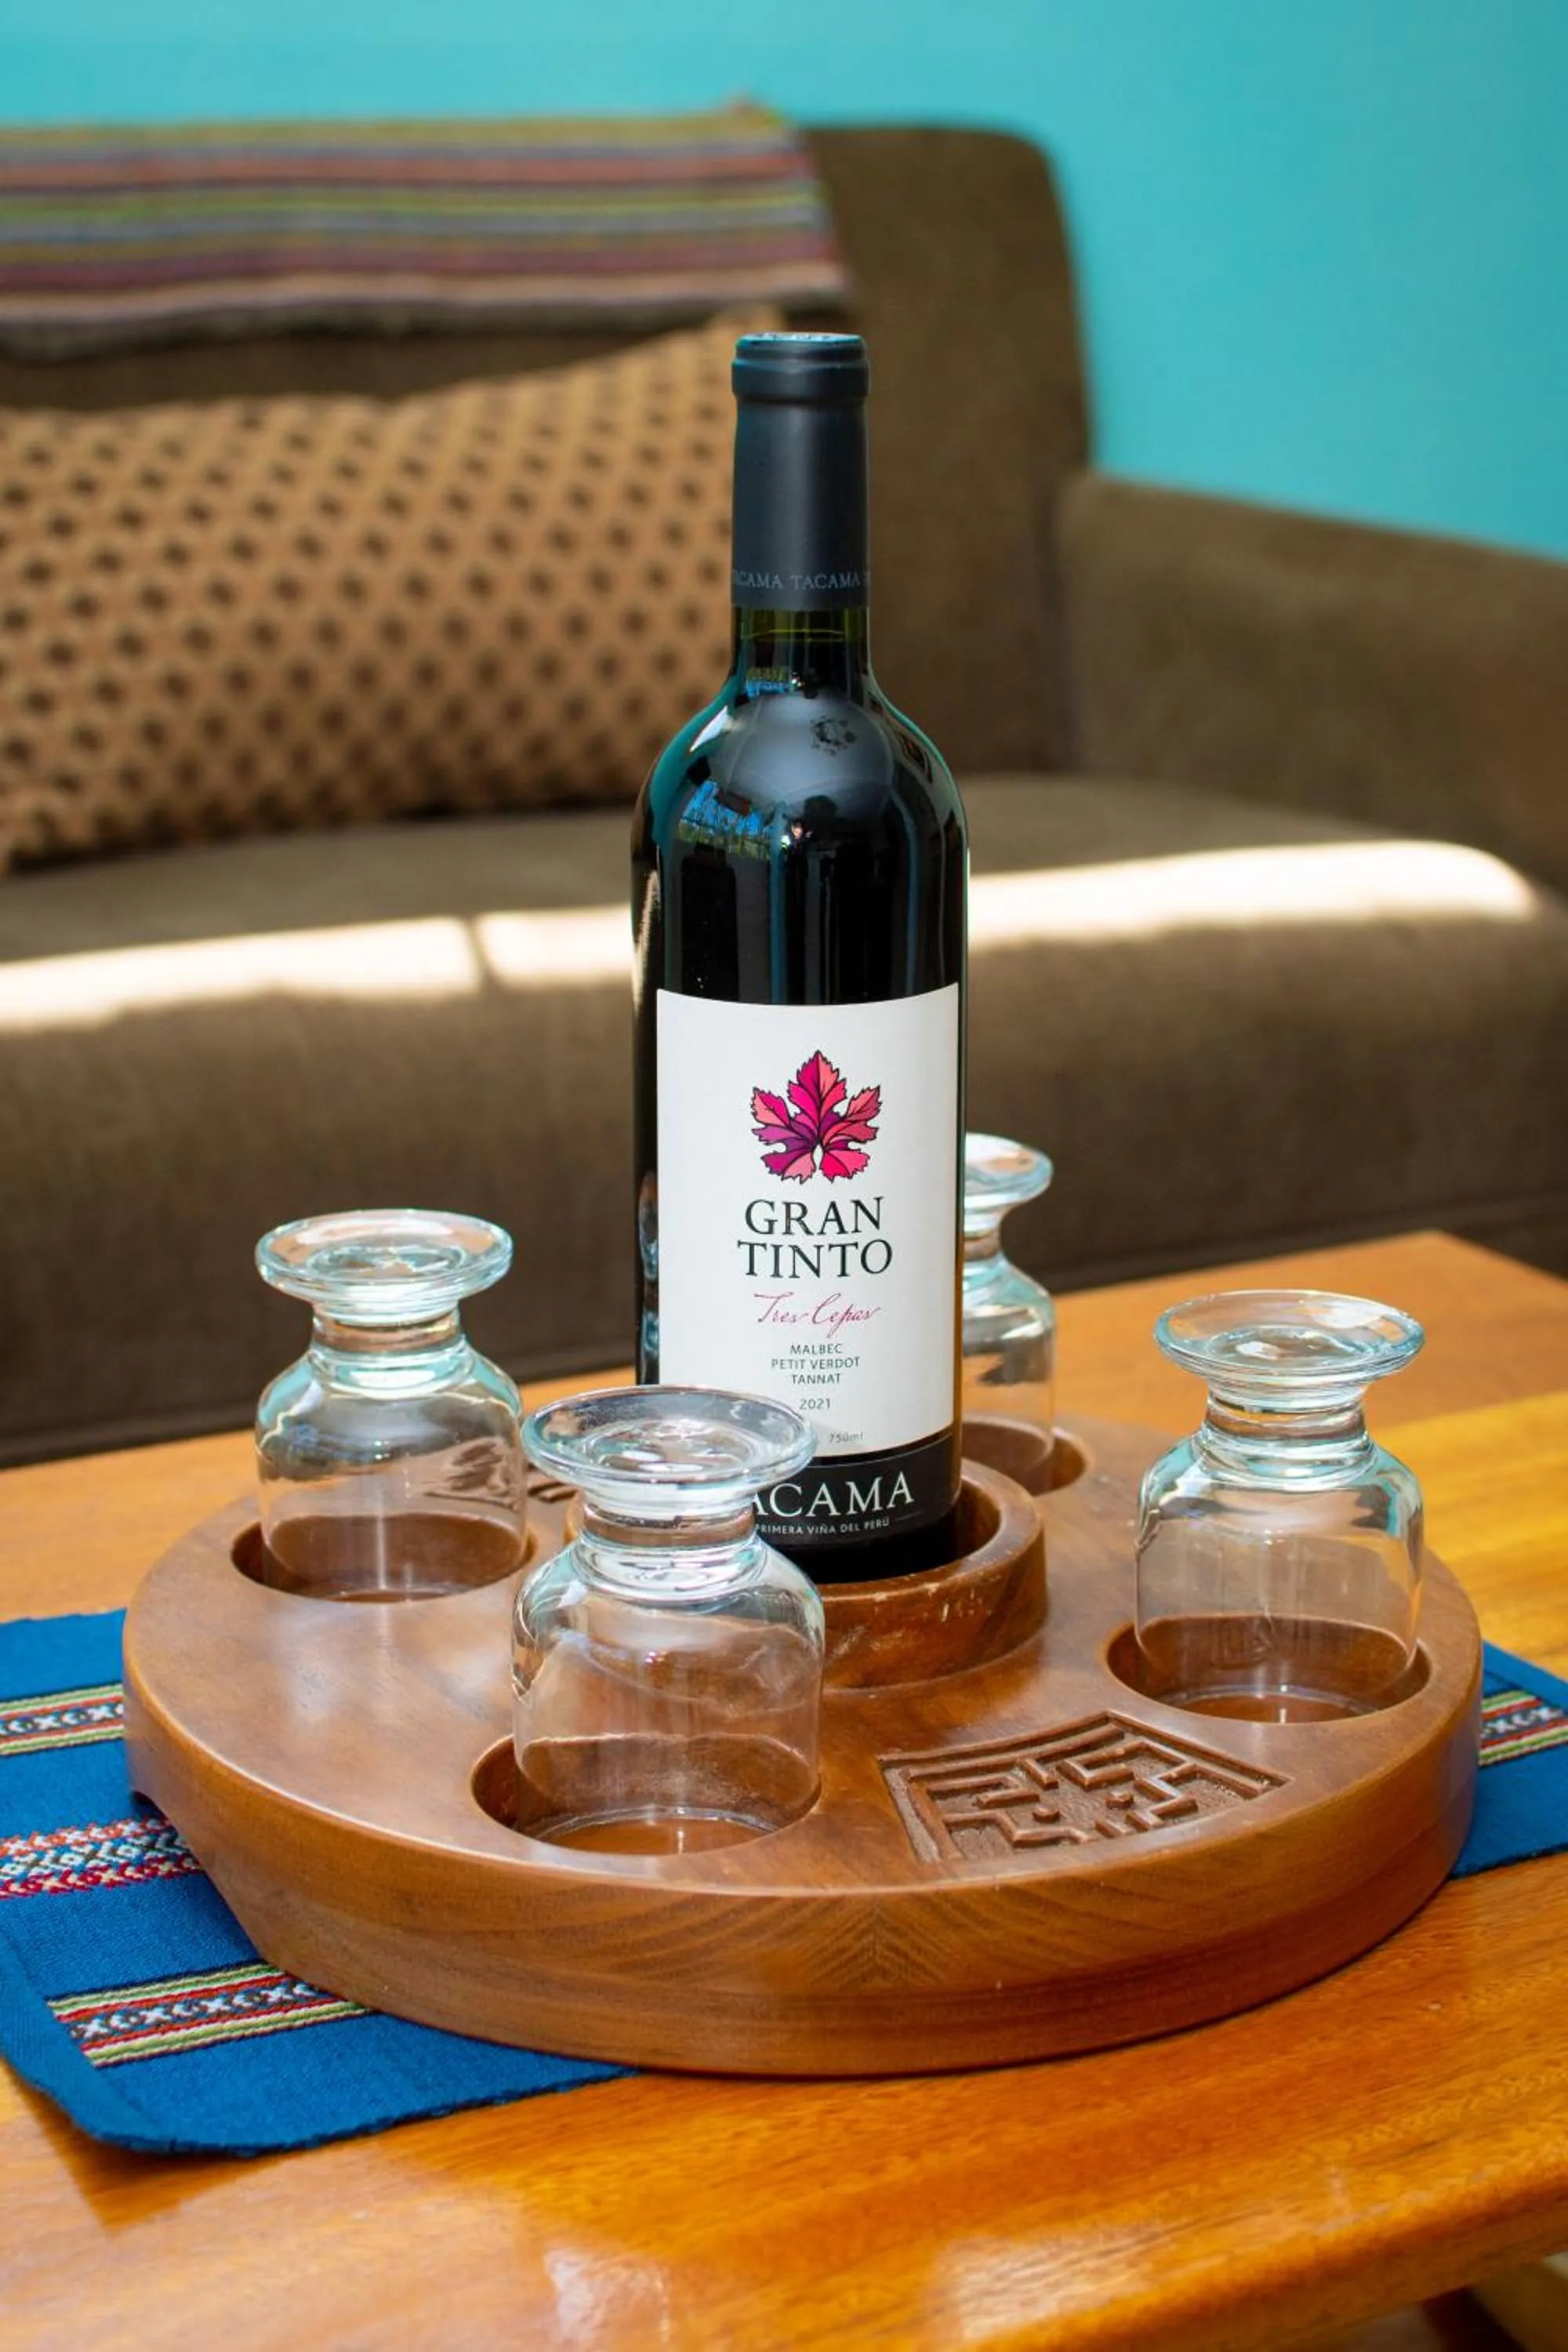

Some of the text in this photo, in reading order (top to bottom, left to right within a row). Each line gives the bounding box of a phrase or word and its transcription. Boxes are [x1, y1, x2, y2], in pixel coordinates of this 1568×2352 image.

[789, 572, 861, 590] TACAMA
[745, 1196, 884, 1236] GRAN
[737, 1239, 893, 1279] TINTO
[753, 1291, 881, 1338] Tres Cepas
[789, 1344, 843, 1355] MALBEC
[771, 1356, 861, 1370] PETIT VERDOT
[792, 1374, 841, 1385] TANNAT
[800, 1398, 831, 1410] 2021
[829, 1431, 864, 1443] 750ml
[807, 1524, 837, 1534] VIÑA
[840, 1523, 860, 1533] DEL
